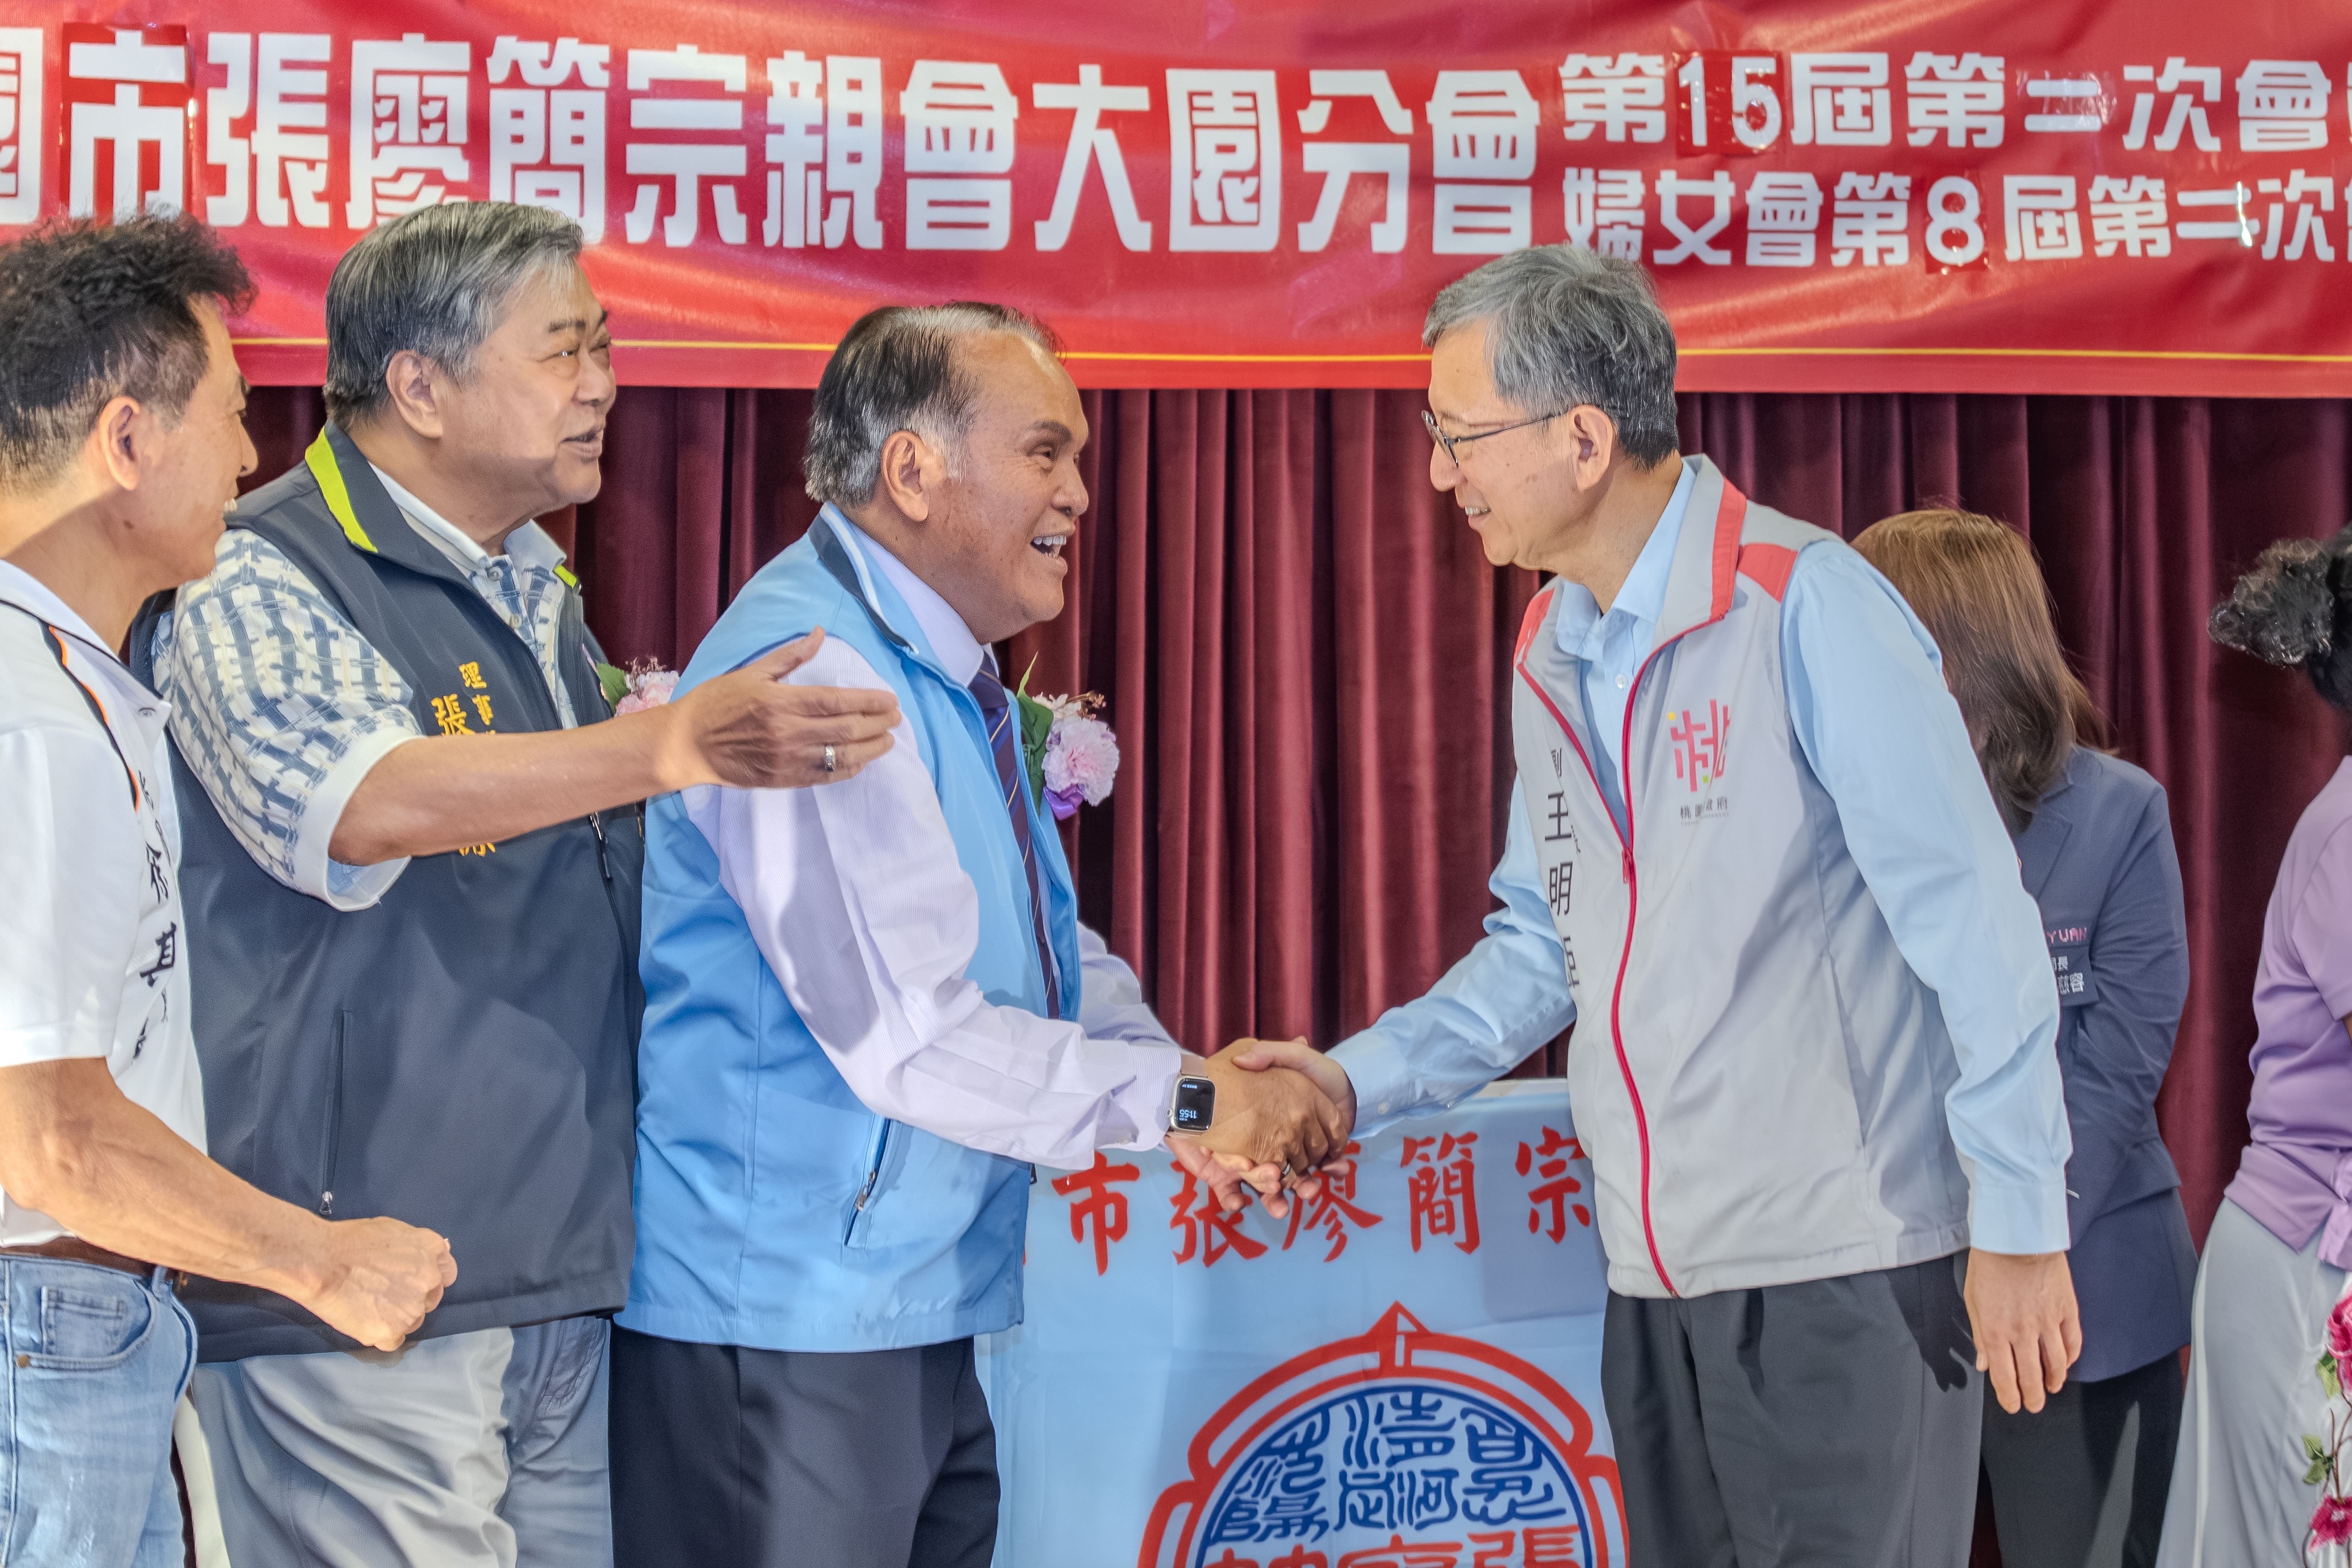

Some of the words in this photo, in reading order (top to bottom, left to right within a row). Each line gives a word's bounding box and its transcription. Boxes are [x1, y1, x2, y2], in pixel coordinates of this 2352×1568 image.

[1559, 51, 2352, 153] 第15屆第二次會
[1562, 167, 2352, 267] 婦女會第8屆第二次
[458, 661, 496, 734] 理事
